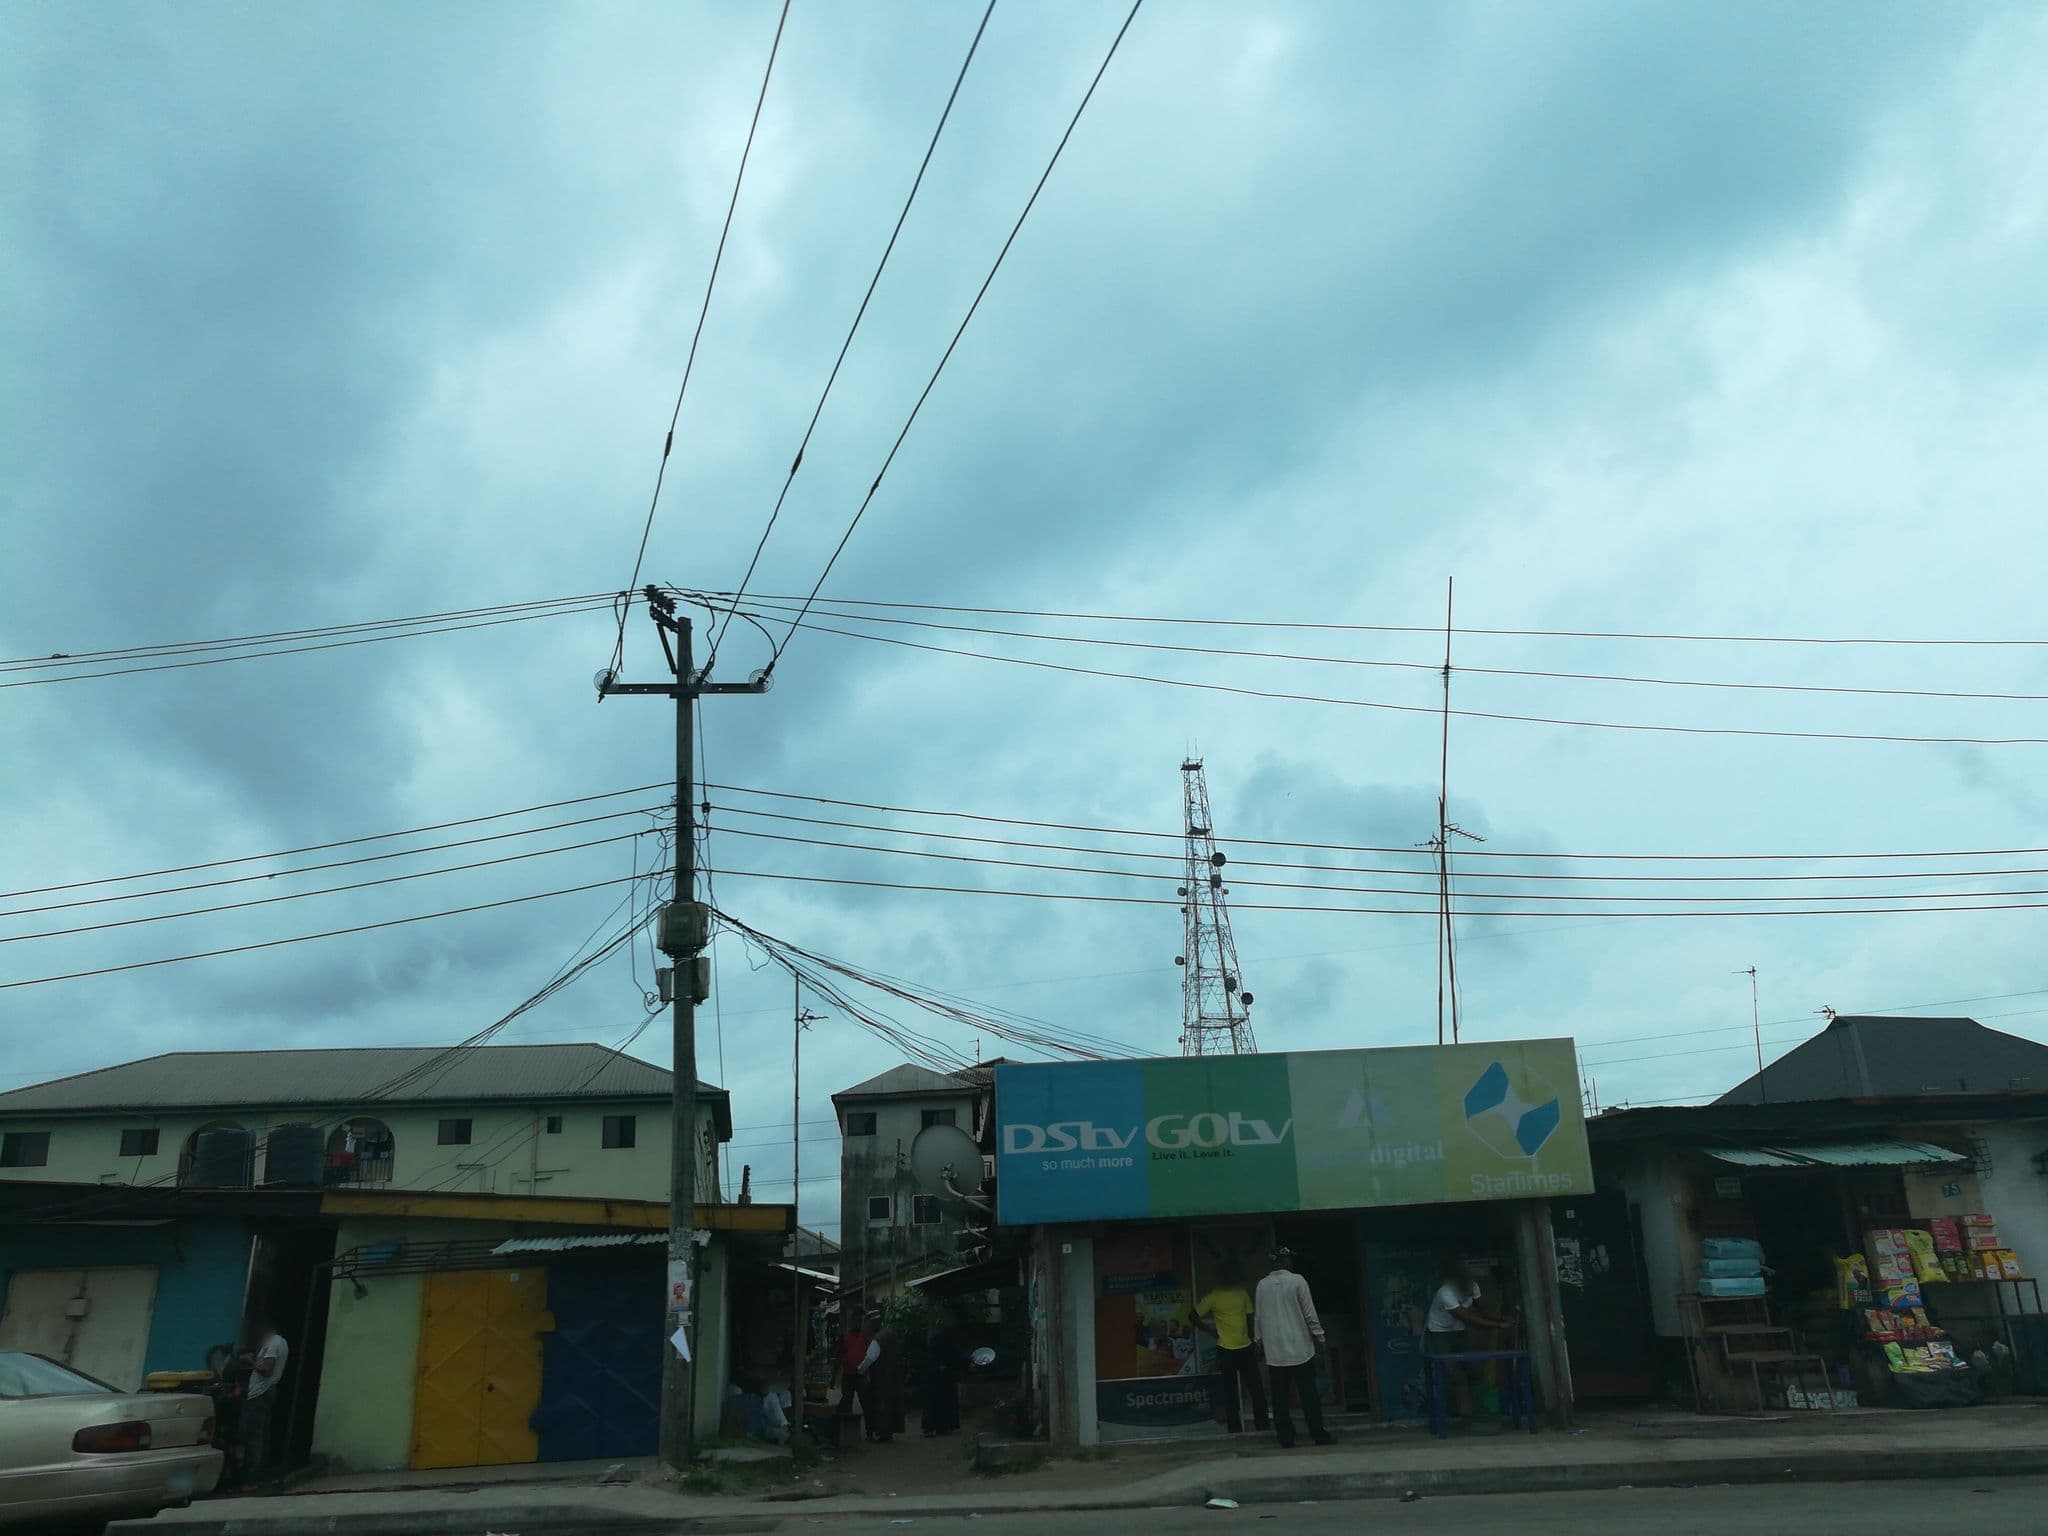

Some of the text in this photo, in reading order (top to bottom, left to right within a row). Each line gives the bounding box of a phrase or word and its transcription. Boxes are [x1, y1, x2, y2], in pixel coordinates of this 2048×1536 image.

[1004, 1121, 1138, 1154] DStv
[1145, 1112, 1293, 1149] GOtv
[1042, 1157, 1133, 1170] so much more
[1152, 1150, 1176, 1161] Live
[1193, 1149, 1220, 1160] Love
[1370, 1140, 1444, 1167] digital
[1126, 1388, 1209, 1408] Spectranet
